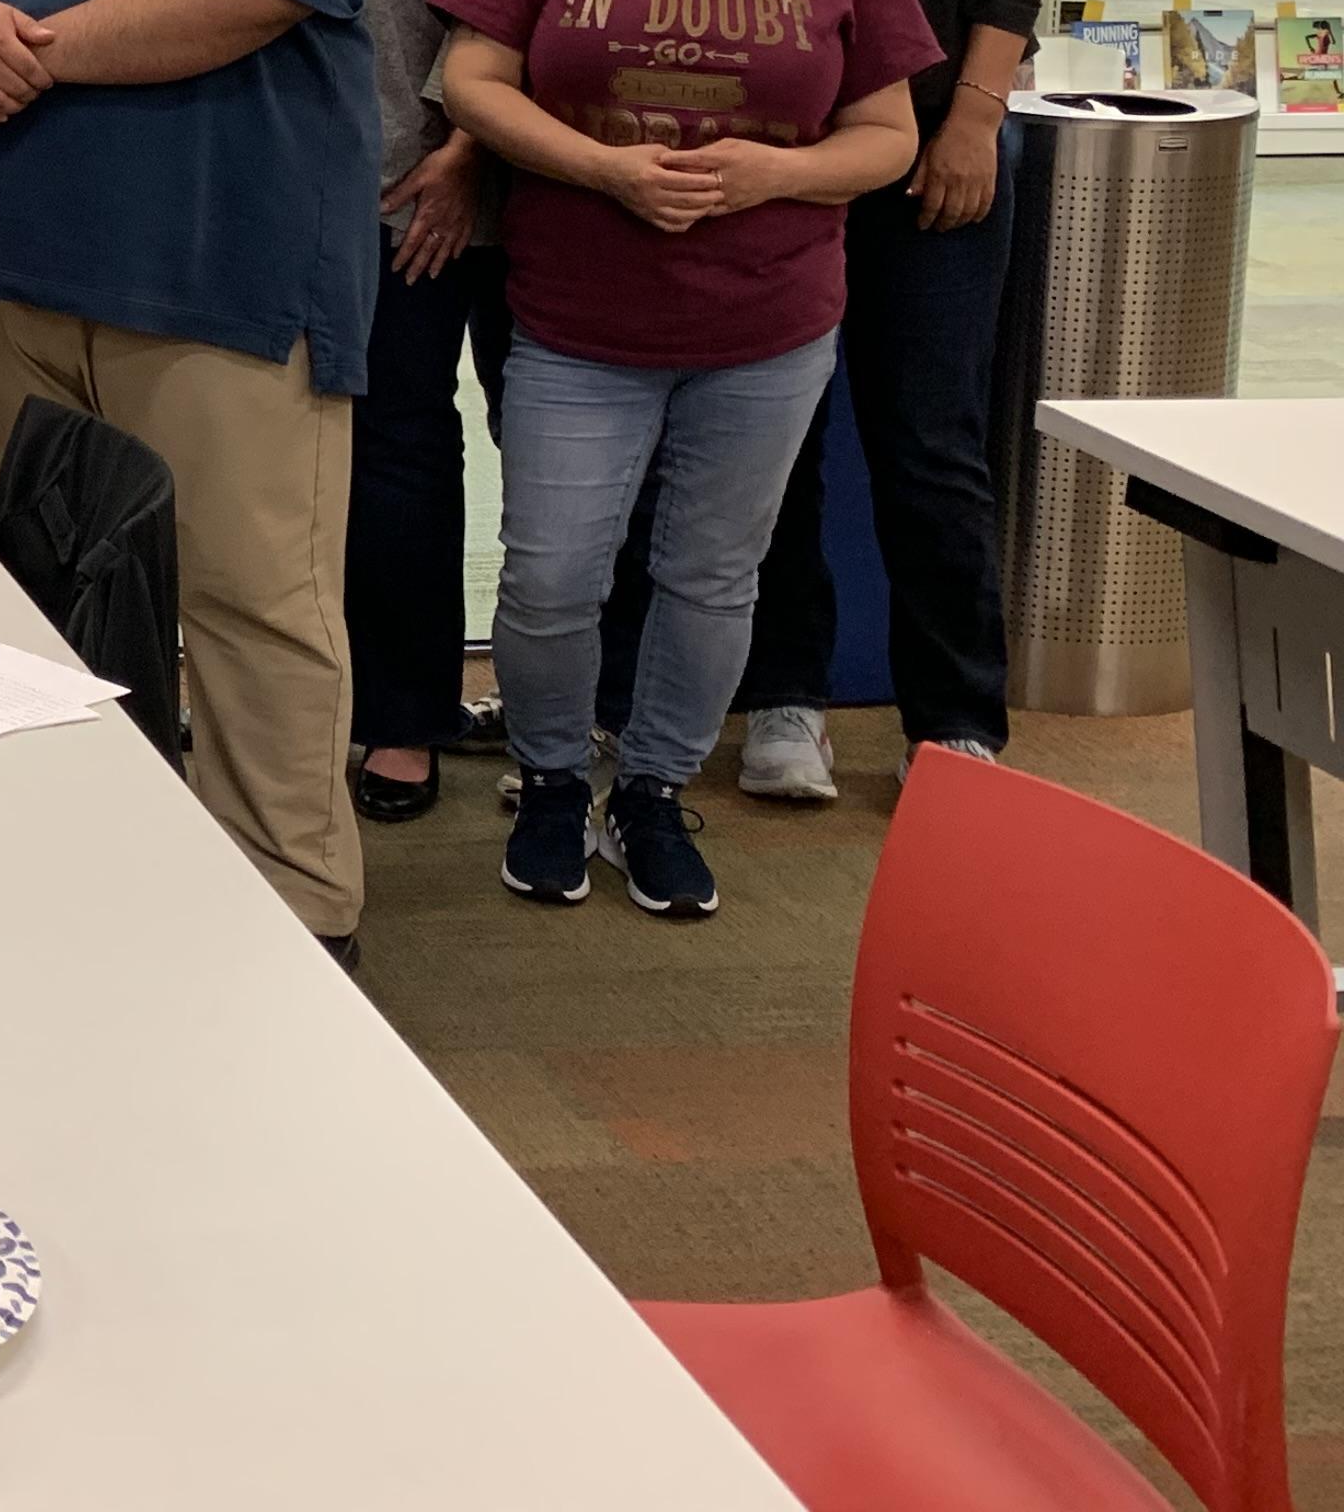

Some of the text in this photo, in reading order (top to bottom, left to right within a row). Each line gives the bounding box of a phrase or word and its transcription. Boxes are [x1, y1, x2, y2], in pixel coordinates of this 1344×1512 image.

[1083, 24, 1139, 44] RUNNING
[654, 39, 703, 66] GO
[1191, 51, 1240, 61] RIDE
[633, 79, 666, 96] TO
